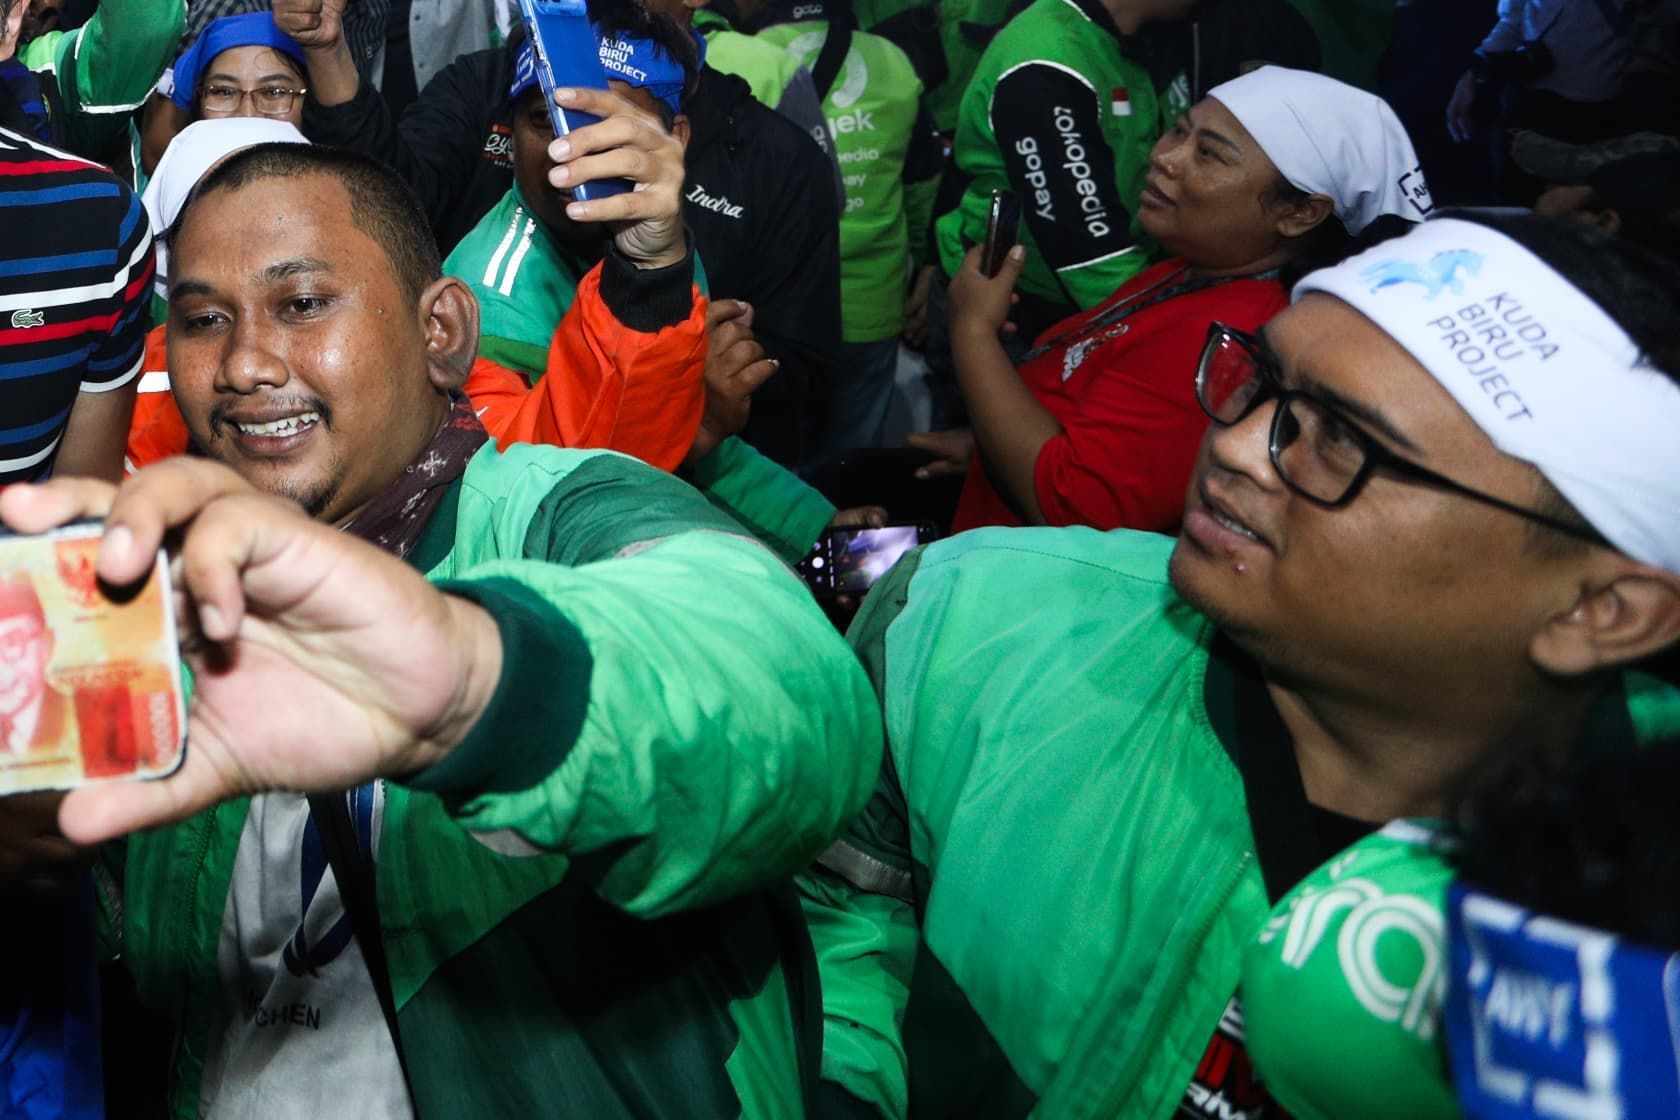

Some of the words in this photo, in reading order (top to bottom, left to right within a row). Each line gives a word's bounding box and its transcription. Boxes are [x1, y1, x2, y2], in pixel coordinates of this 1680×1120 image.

[599, 46, 628, 64] BIRU
[1015, 136, 1056, 221] gopay
[1456, 302, 1525, 361] BIRU
[1485, 291, 1560, 361] KUDA
[1426, 315, 1534, 421] PROJECT
